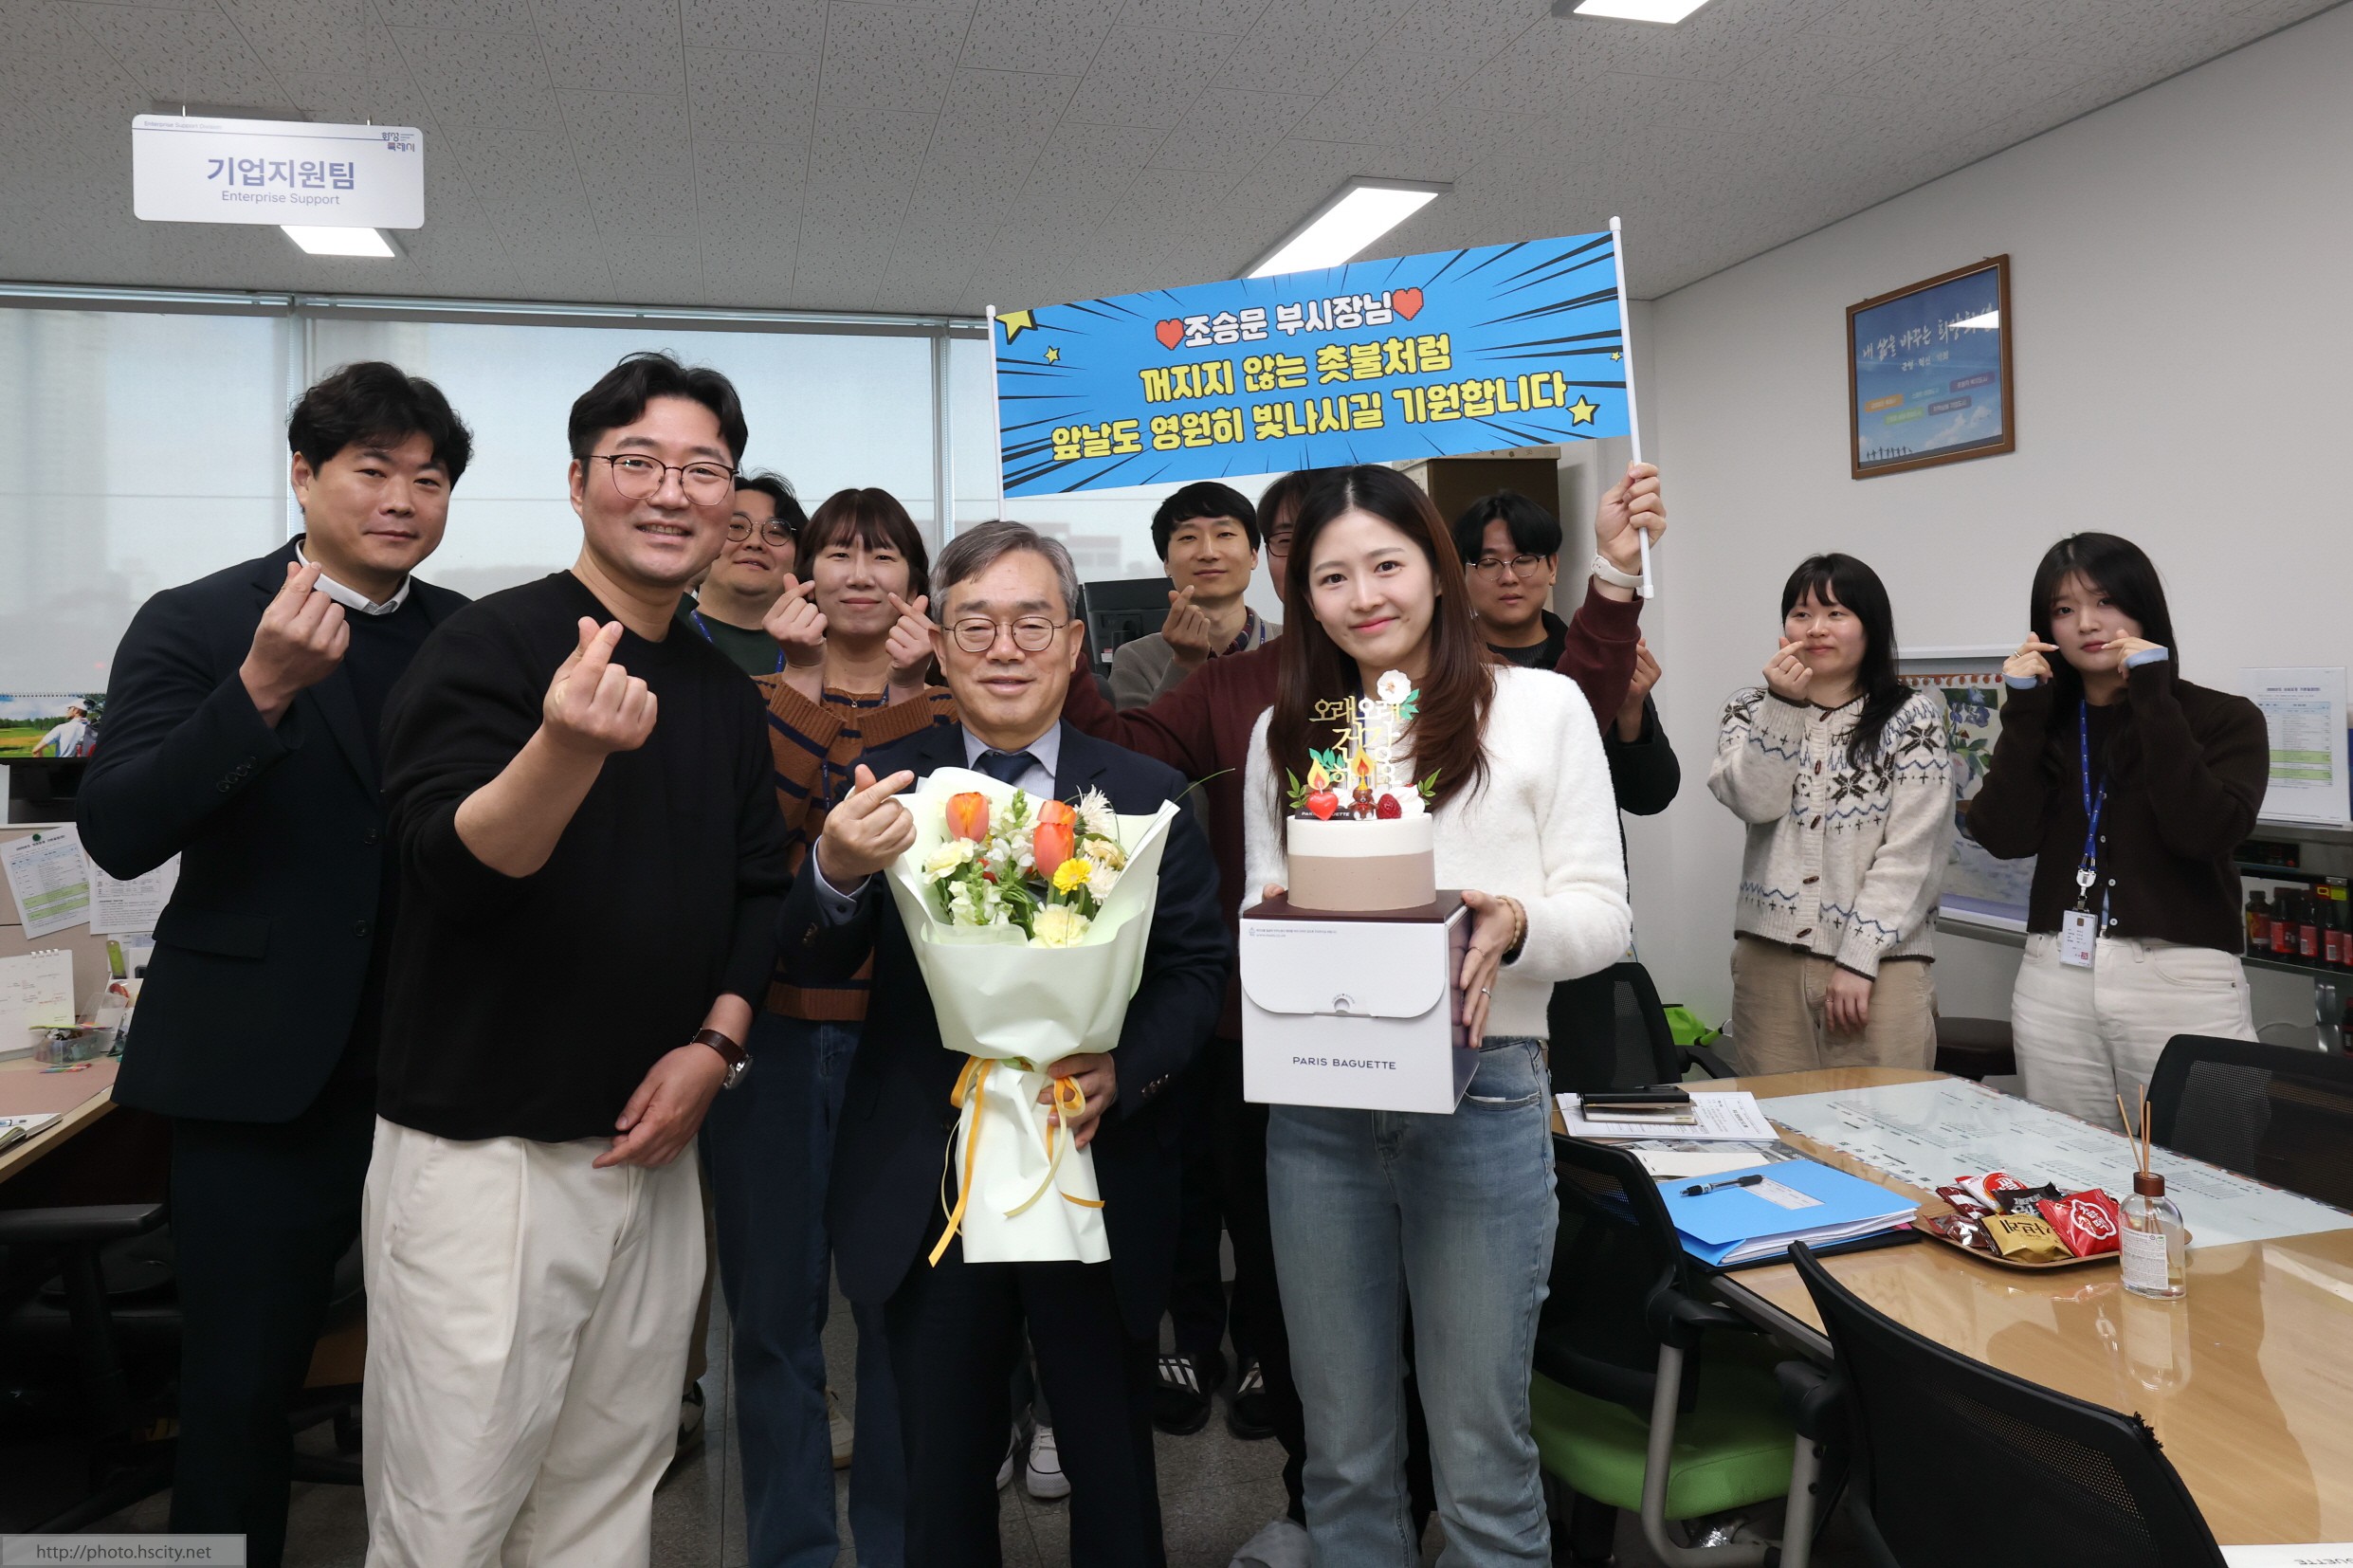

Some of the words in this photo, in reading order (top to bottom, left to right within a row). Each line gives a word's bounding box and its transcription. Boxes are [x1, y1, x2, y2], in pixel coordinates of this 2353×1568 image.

[207, 156, 355, 190] 기업지원팀
[221, 190, 286, 205] Enterprise
[289, 192, 340, 206] Support
[1183, 306, 1268, 348] 조승문
[1275, 290, 1394, 336] 부시장님
[1140, 358, 1234, 404] 꺼지지
[1242, 353, 1308, 393] 않는
[1315, 332, 1452, 385] 촛불처럼
[1050, 418, 1143, 462] 앞날도
[1149, 406, 1245, 451] 영원히
[1251, 390, 1386, 442] 빛나시길
[1391, 370, 1568, 424] 기원합니다
[1309, 695, 1401, 722] 오래오래
[1292, 1056, 1328, 1067] PARIS
[1332, 1058, 1396, 1070] BAGUETTE
